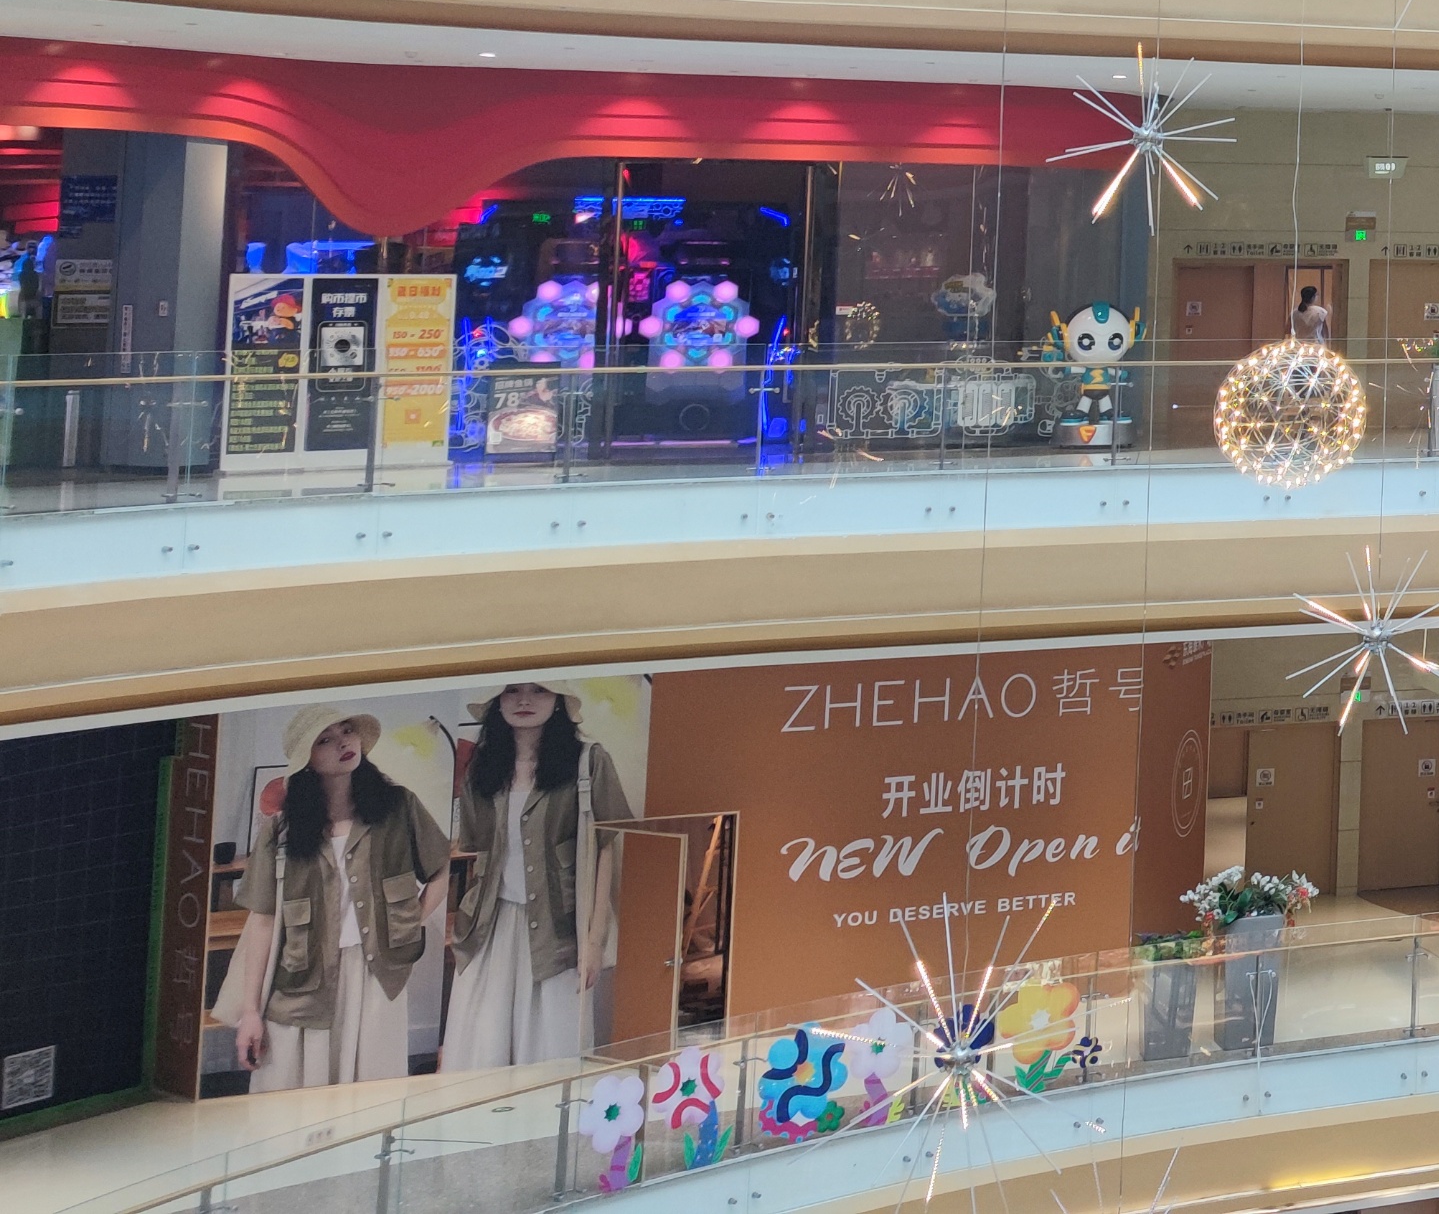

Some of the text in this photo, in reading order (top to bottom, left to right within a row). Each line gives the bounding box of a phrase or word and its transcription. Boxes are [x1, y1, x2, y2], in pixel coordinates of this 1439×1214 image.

[494, 393, 519, 407] 78
[780, 667, 1144, 734] ZHEHAO 哲号
[881, 764, 1066, 820] 开业倒计时
[968, 824, 1101, 877] Open
[833, 891, 1077, 929] YOU DESERVE BETTER
